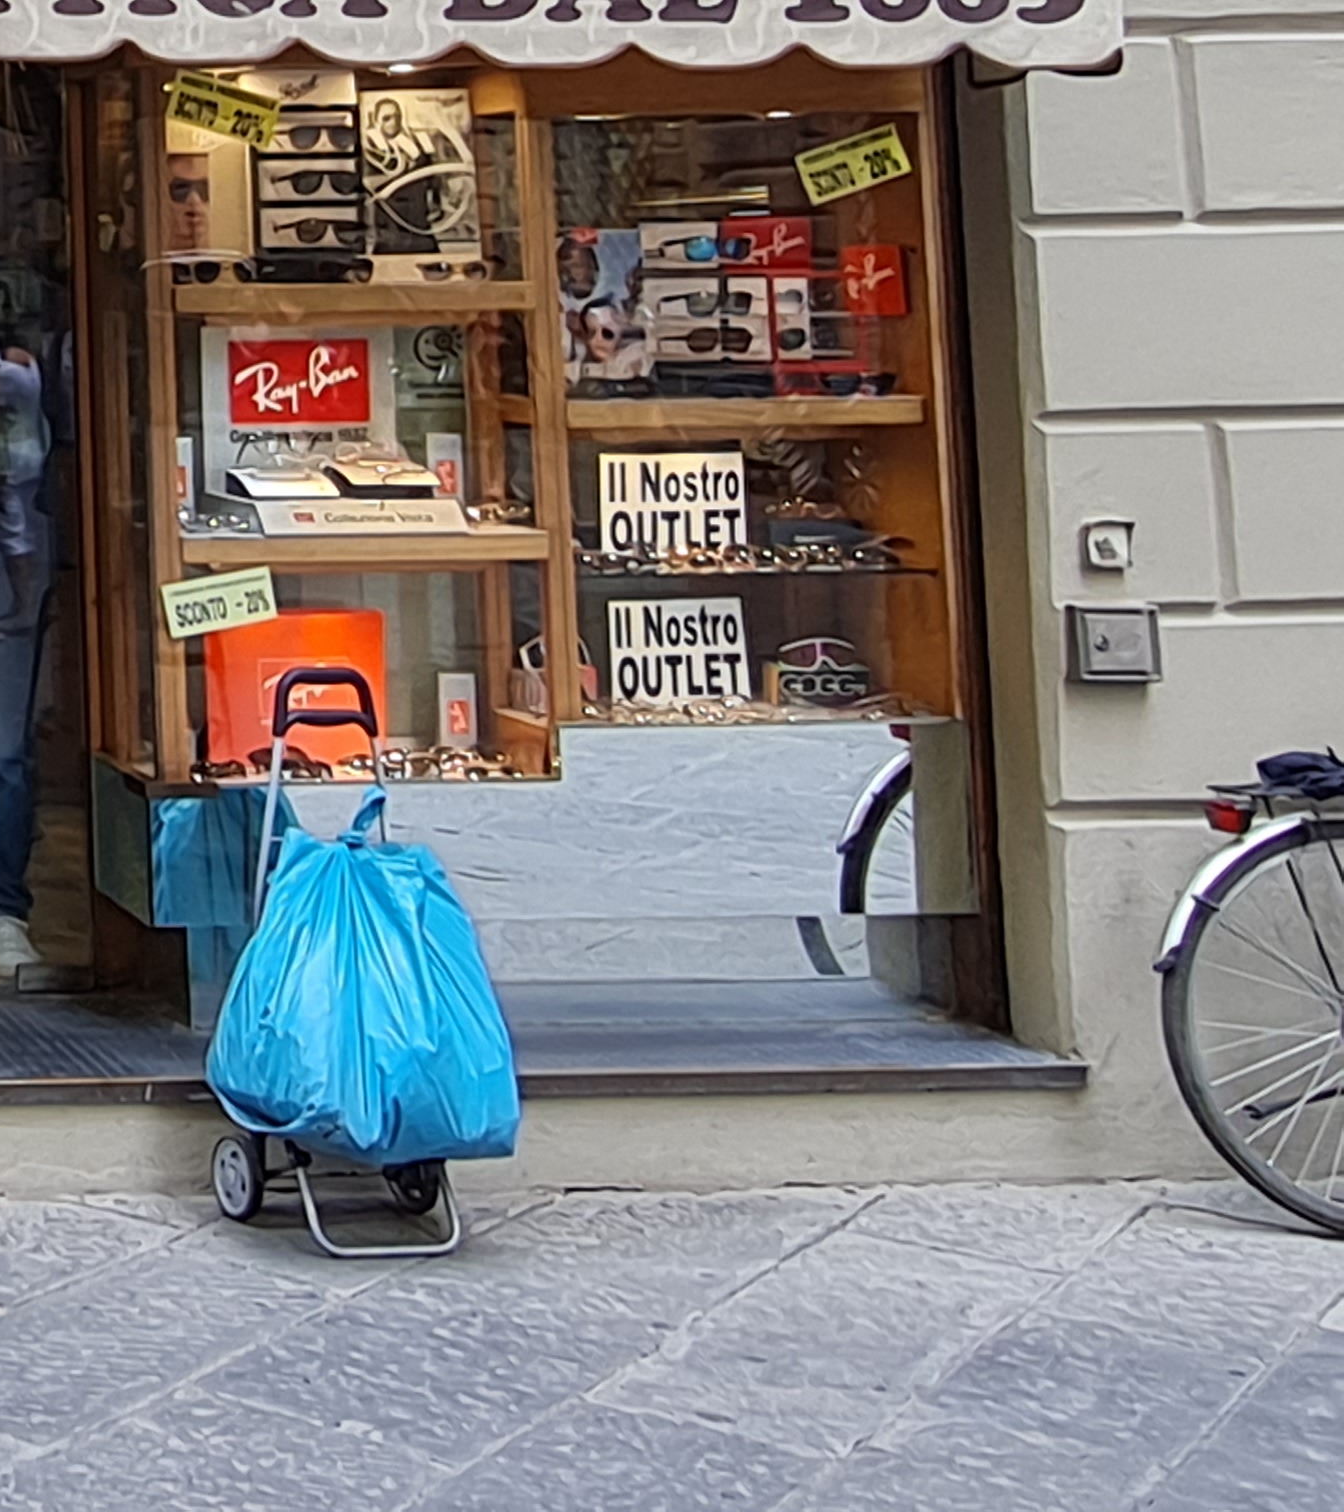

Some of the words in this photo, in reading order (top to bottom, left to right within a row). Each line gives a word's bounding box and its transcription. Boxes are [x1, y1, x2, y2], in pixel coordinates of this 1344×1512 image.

[234, 344, 360, 415] Ray-Ban
[608, 461, 627, 503] Il
[639, 459, 740, 503] Nostro
[609, 507, 742, 552] OUTLET
[614, 606, 632, 649] Il
[642, 603, 738, 648] Nostro
[617, 652, 742, 702] OUTLET
